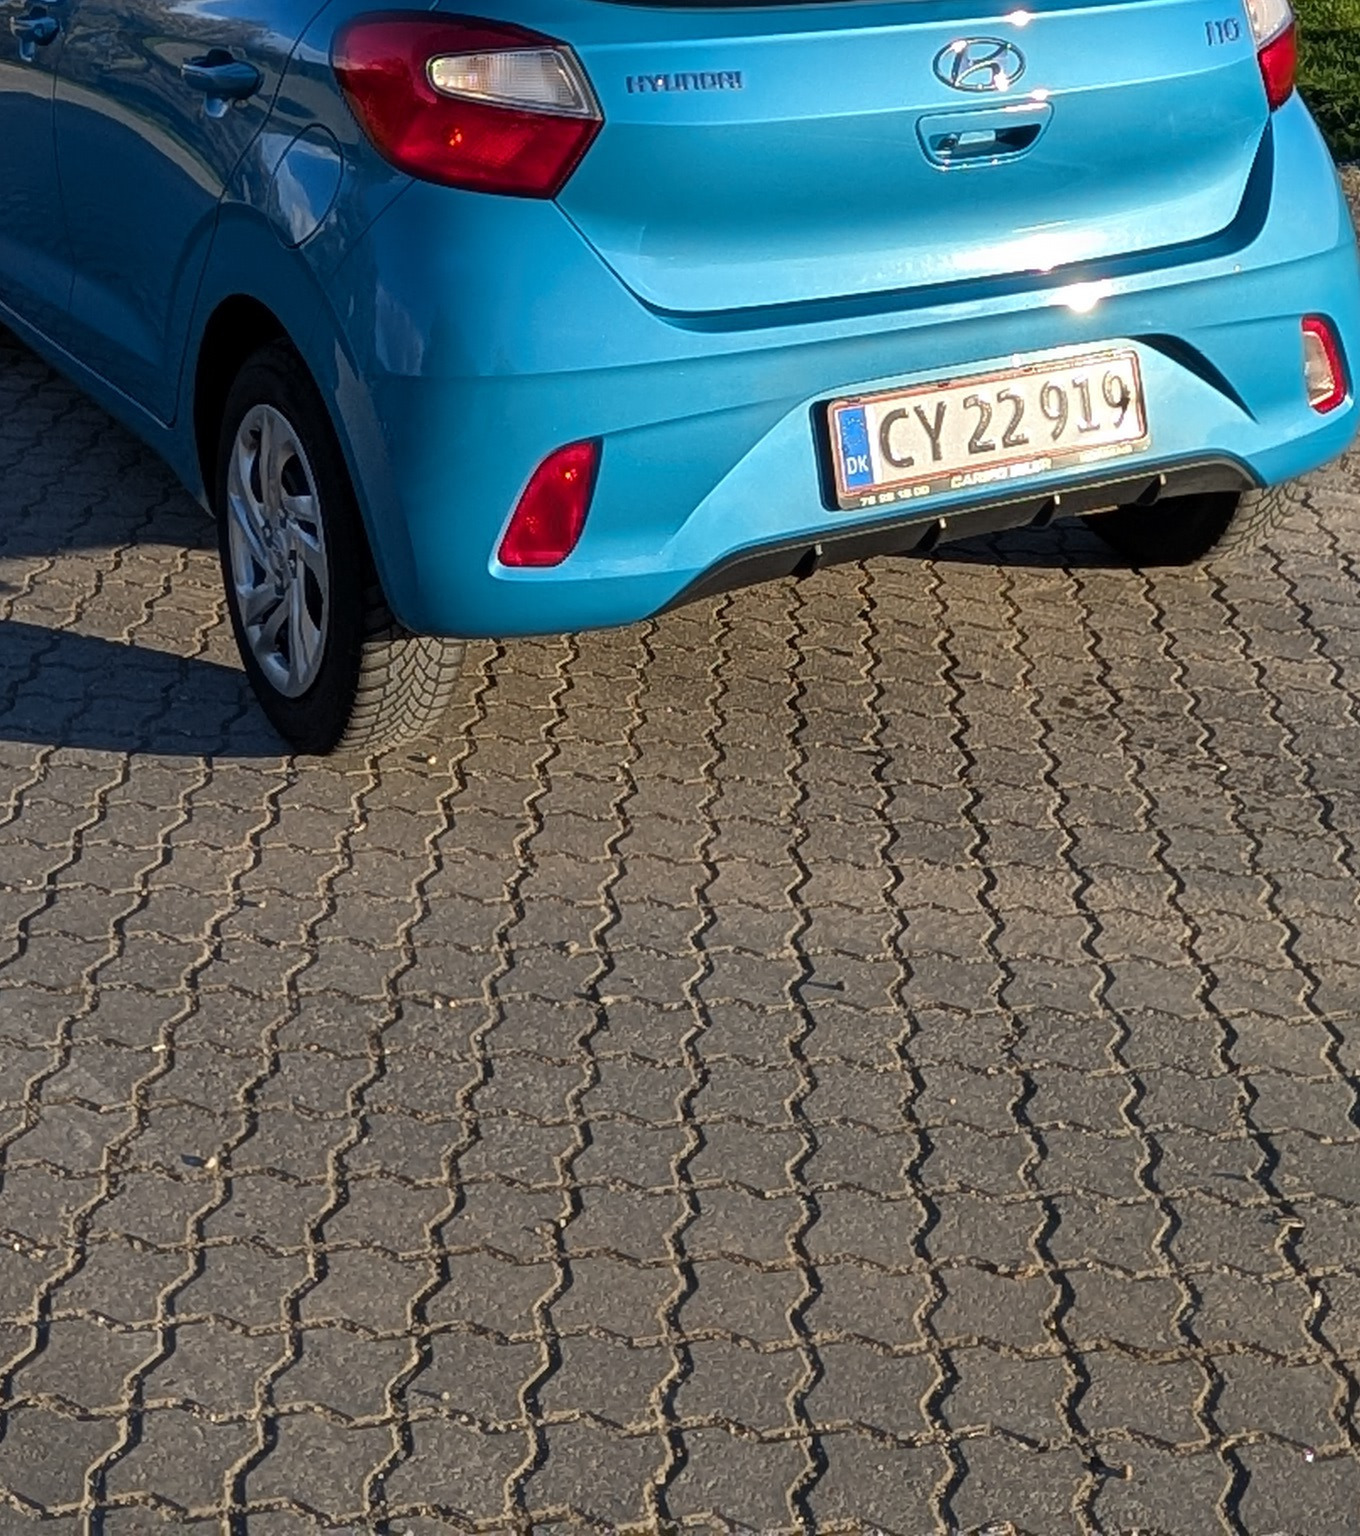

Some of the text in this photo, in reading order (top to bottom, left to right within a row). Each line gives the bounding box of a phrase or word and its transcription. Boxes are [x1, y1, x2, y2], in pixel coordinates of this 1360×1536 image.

[625, 70, 743, 94] HYUNDAI
[879, 370, 1132, 468] CY 22 919
[846, 454, 870, 476] DK
